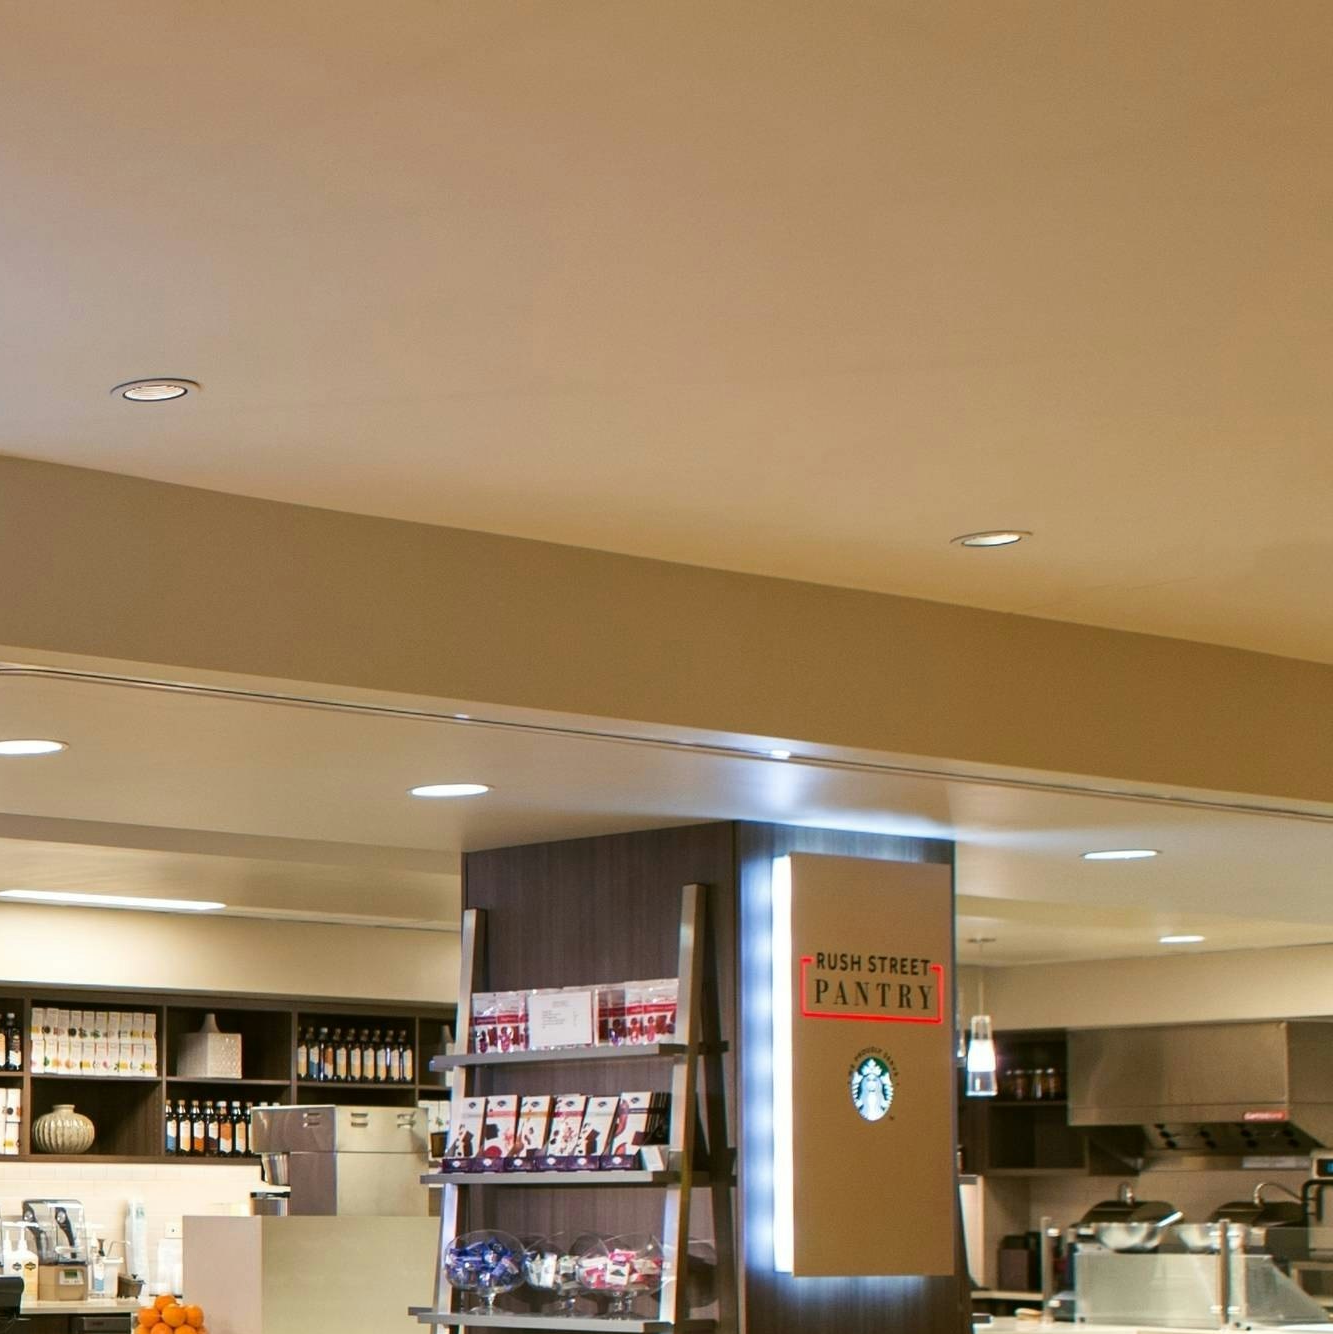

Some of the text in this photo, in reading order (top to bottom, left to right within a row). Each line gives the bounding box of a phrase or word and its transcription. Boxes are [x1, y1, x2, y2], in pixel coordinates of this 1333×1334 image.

[817, 952, 931, 976] RUSH STREET
[815, 979, 932, 1010] PANTRY
